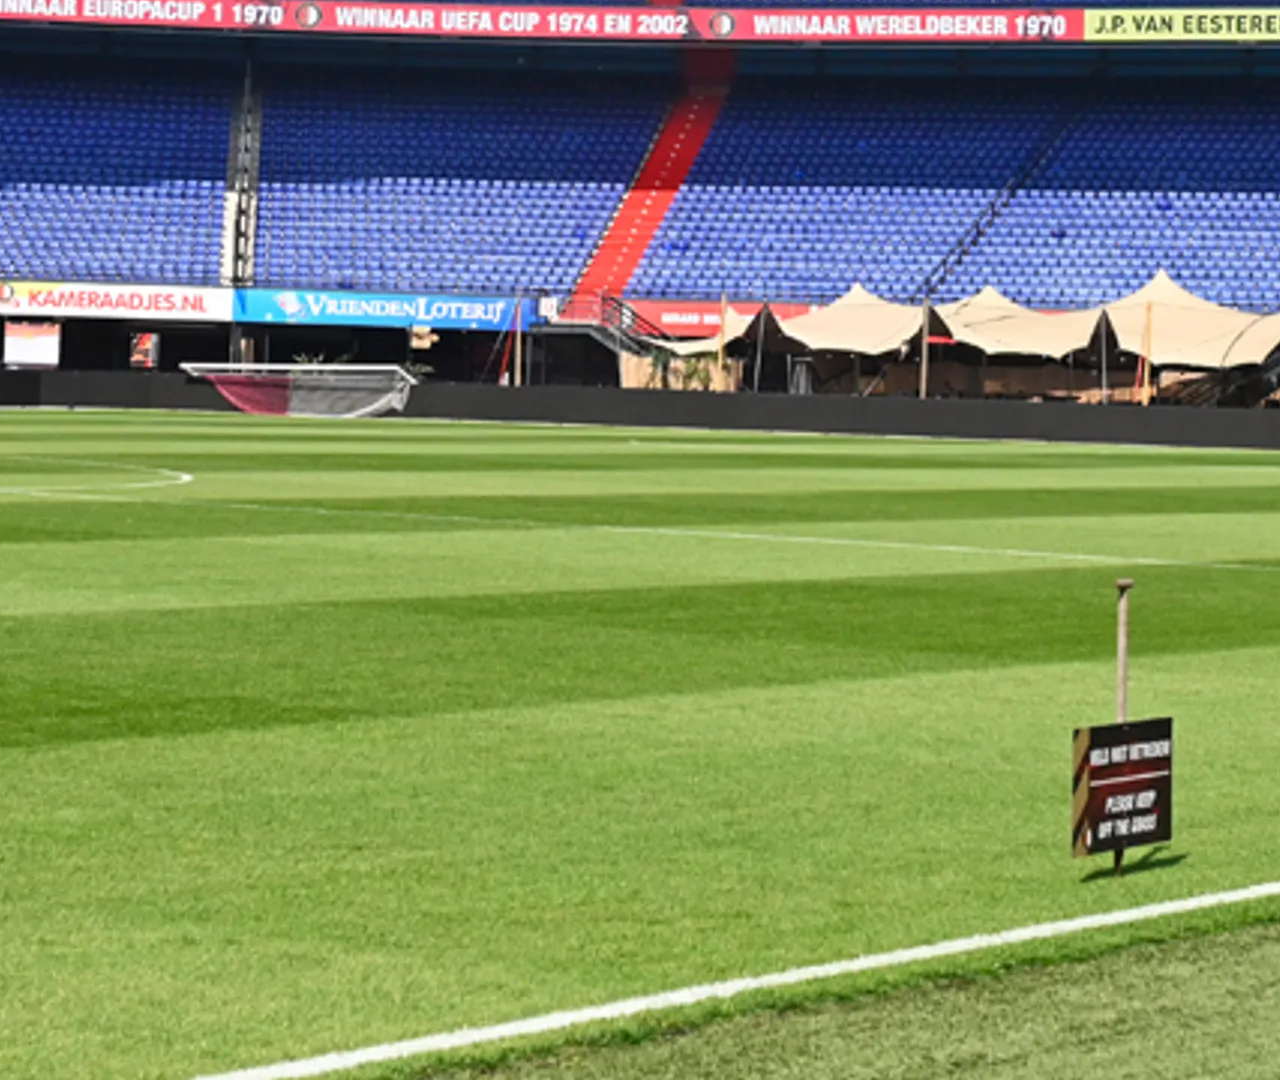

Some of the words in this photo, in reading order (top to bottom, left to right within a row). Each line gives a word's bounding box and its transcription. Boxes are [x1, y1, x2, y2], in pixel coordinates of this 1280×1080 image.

[212, 2, 223, 22] 1
[232, 3, 284, 25] 1970
[335, 6, 435, 29] WINNAAR
[441, 9, 493, 31] UEFA
[498, 11, 540, 32] CUP
[547, 12, 598, 33] 1974
[604, 14, 632, 34] EN
[637, 14, 688, 35] 2002
[1094, 15, 1127, 34] J.P.
[1132, 15, 1173, 33] VAN
[753, 15, 851, 35] WINNAAR
[855, 15, 1008, 36] WERELDBEKER
[1015, 15, 1066, 36] 1970
[27, 288, 208, 313] KAMERAADJES.NL
